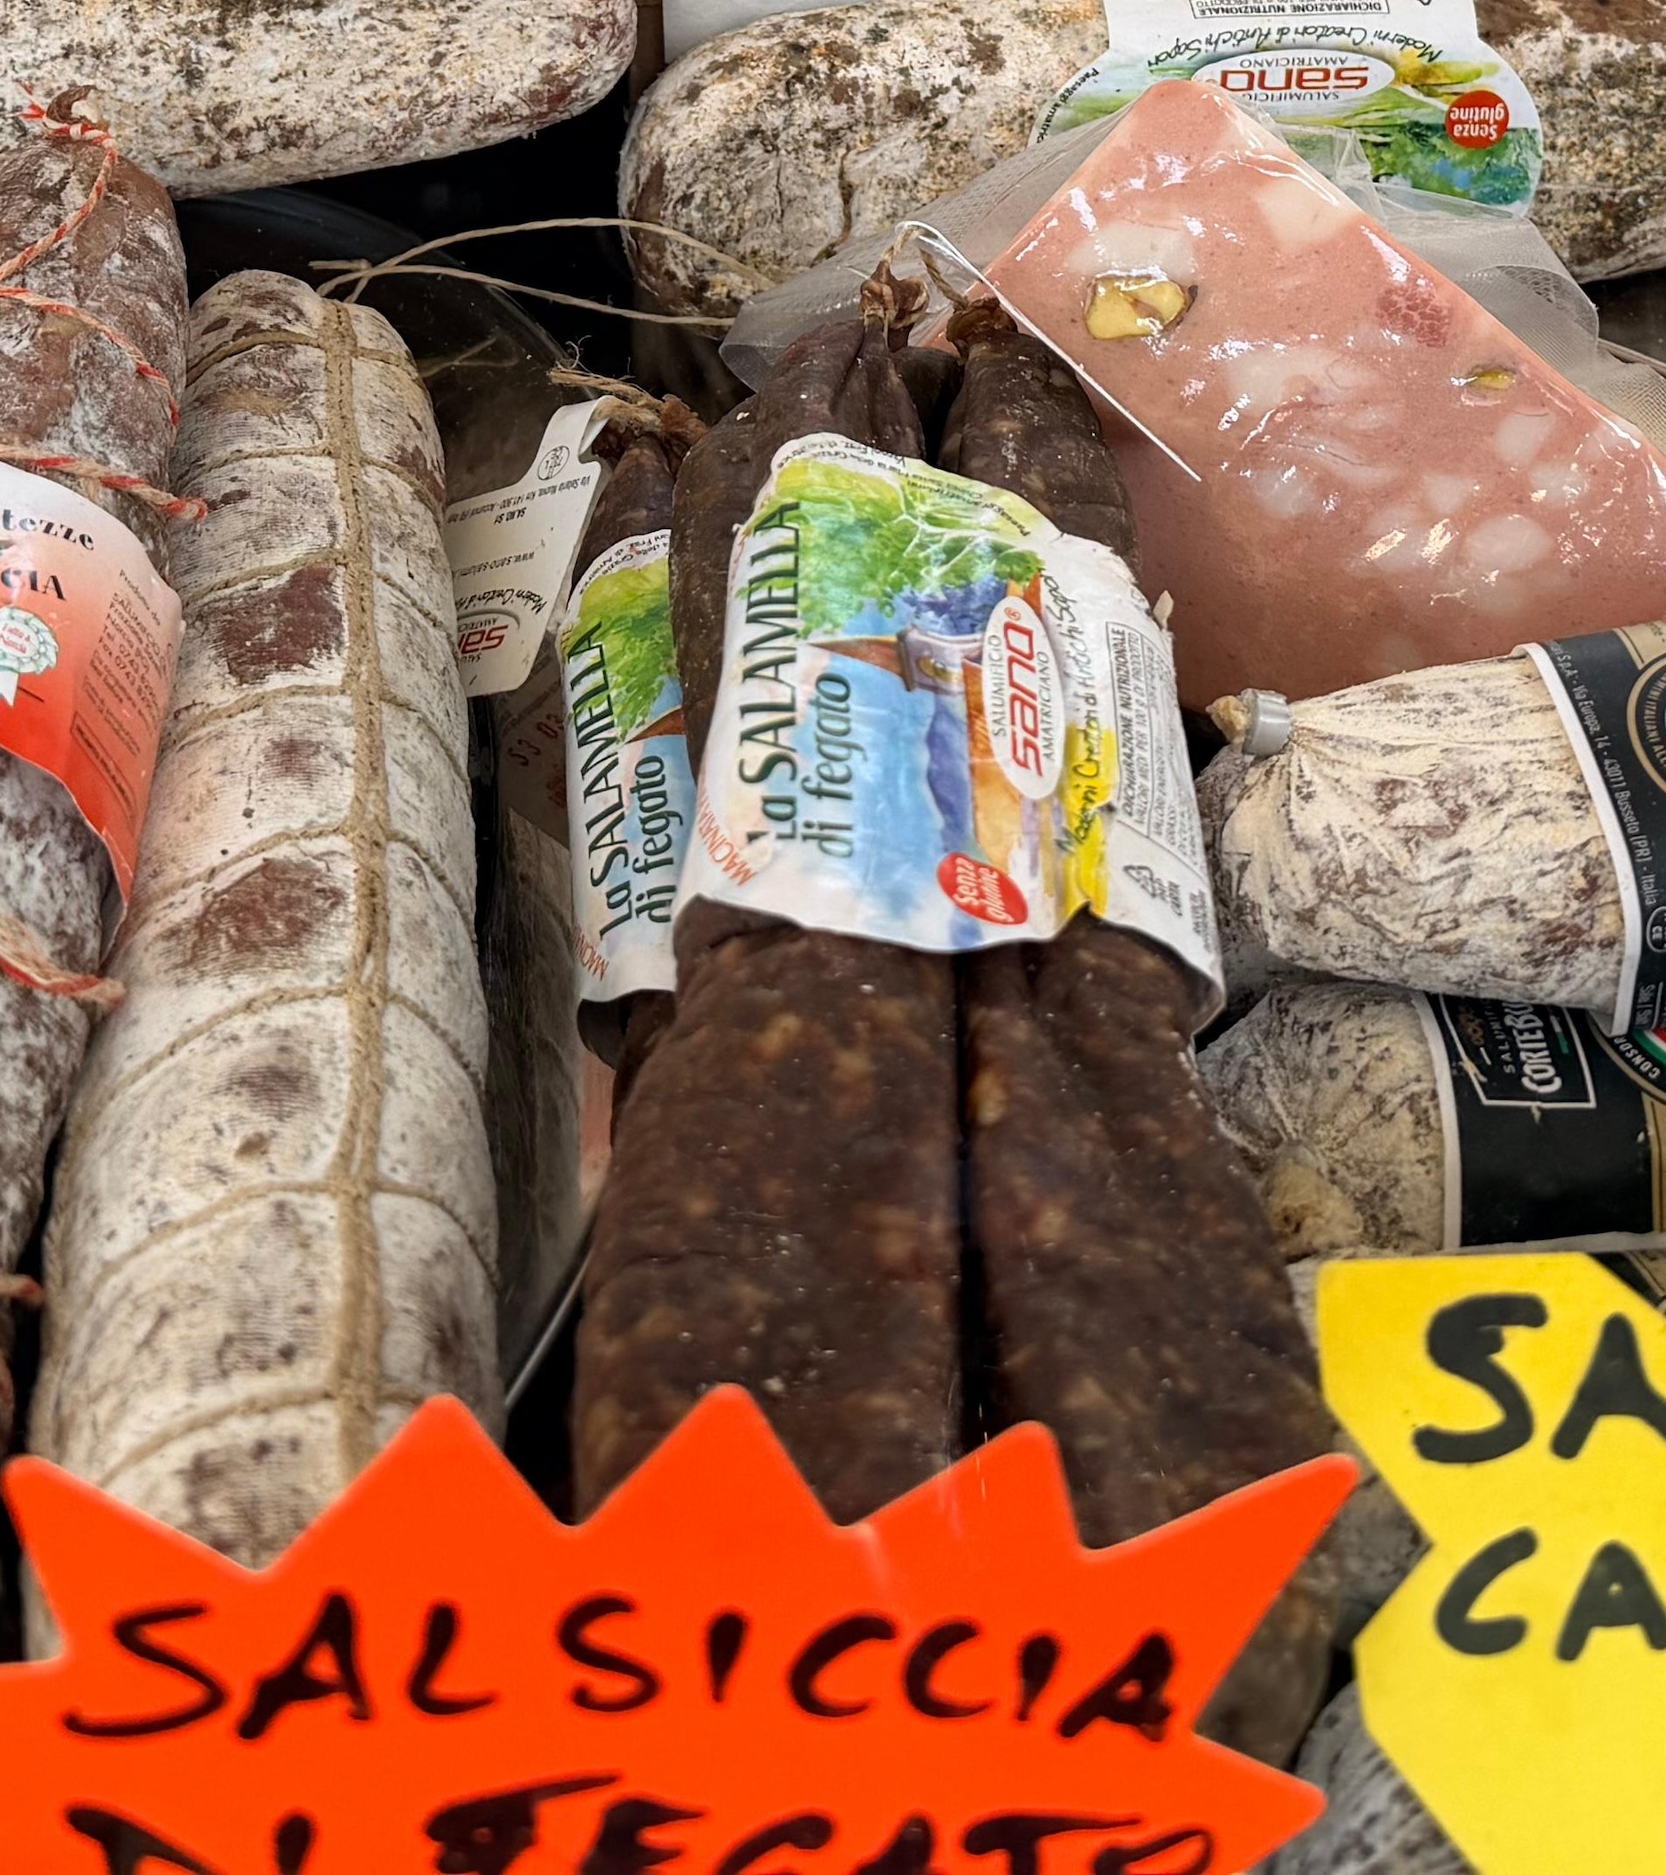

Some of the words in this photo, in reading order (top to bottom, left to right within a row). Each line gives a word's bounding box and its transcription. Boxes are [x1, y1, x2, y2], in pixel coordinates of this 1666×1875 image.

[1197, 4, 1285, 16] NUTRIZIONALE
[1289, 0, 1381, 13] DICHIARAZIONE
[1203, 25, 1271, 53] Antichi
[1293, 24, 1367, 46] Creatori
[1368, 28, 1442, 62] Moderni
[1219, 65, 1369, 92] sano
[1238, 56, 1347, 67] AMATRICIANO
[1448, 104, 1504, 123] glutine
[1452, 121, 1498, 139] Senza
[738, 500, 801, 785] SALAMELLA
[990, 632, 1009, 738] SALUMIFICIO
[1111, 626, 1128, 713] NUTRIZIONALE
[1006, 623, 1044, 778] sano
[1036, 650, 1059, 766] AMATRICIANO
[567, 621, 629, 883] SALAMELLA
[803, 672, 869, 803] fegato
[1116, 716, 1135, 818] DICHIARAZIONE
[1602, 758, 1627, 791] 43011
[632, 754, 683, 879] fegato
[1613, 789, 1641, 836] Busseto
[802, 813, 854, 860] di
[952, 855, 978, 907] Senza
[984, 865, 1015, 924] glutine
[1640, 872, 1659, 906] Italia
[600, 885, 633, 939] La
[634, 890, 672, 924] di
[62, 1589, 1179, 1741] SALSICCIA
